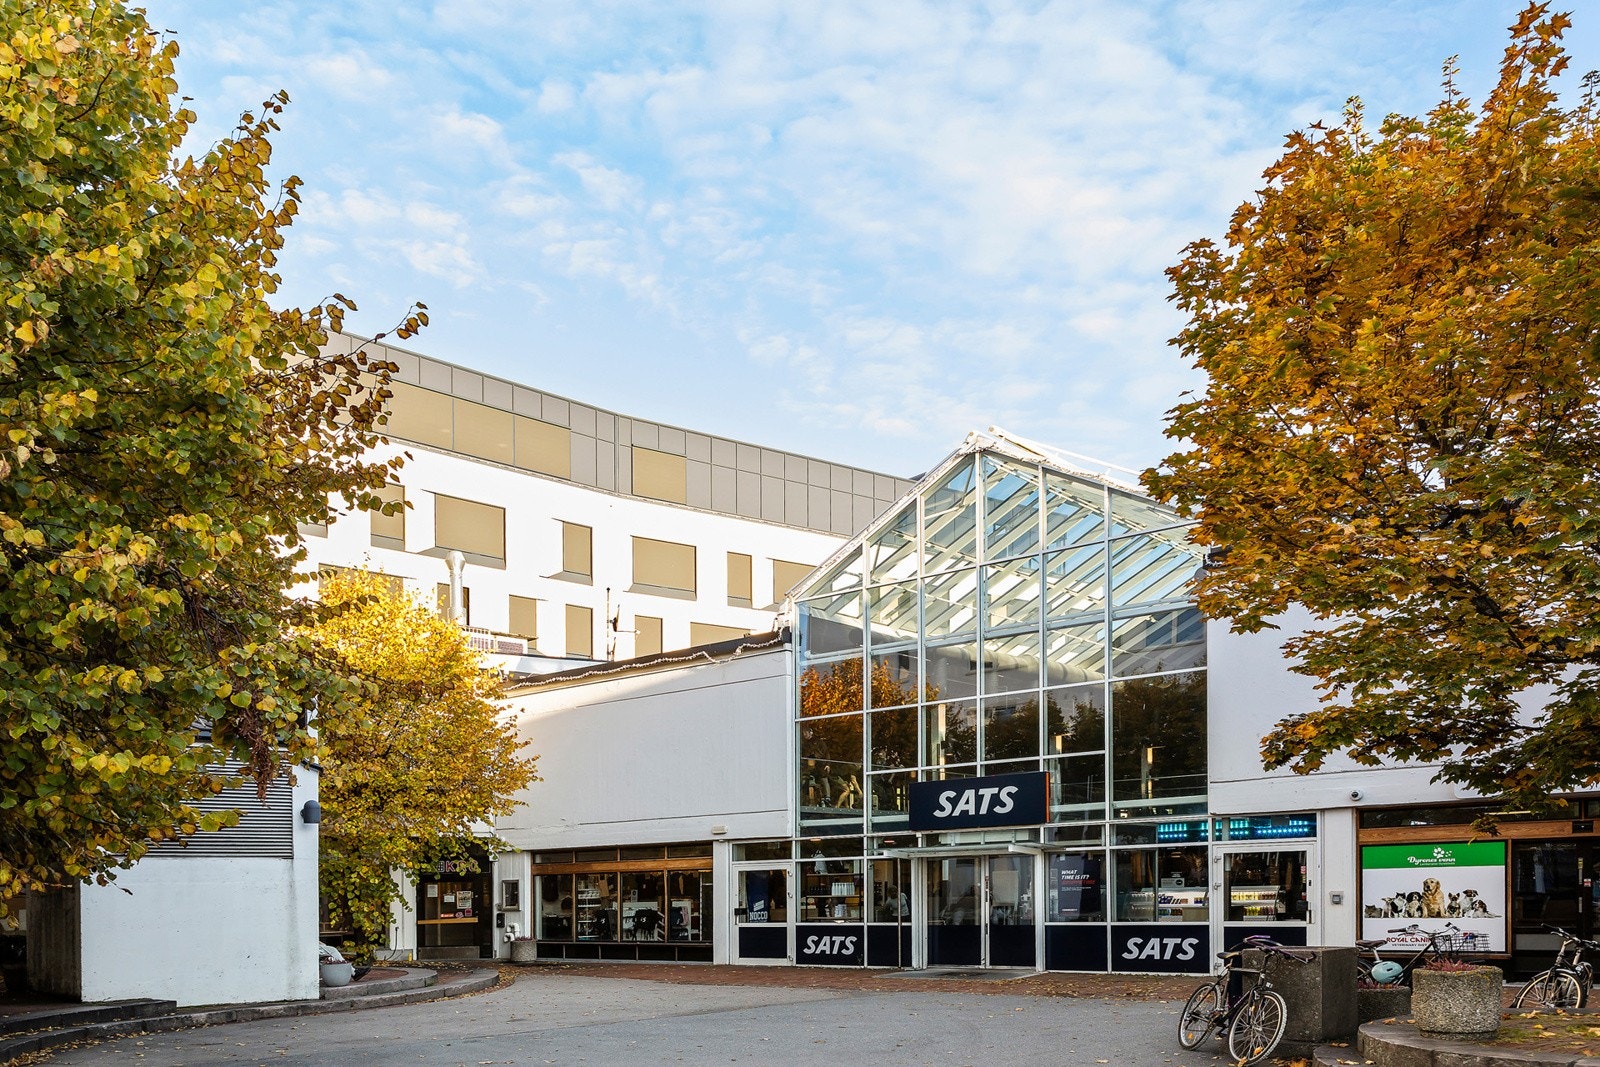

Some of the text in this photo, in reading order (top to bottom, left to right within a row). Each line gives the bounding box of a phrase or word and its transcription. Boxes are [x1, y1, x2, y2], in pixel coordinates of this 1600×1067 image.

[933, 785, 1018, 818] SATS
[749, 911, 768, 920] NOCCO
[803, 935, 858, 955] SATS
[1121, 937, 1200, 960] SATS
